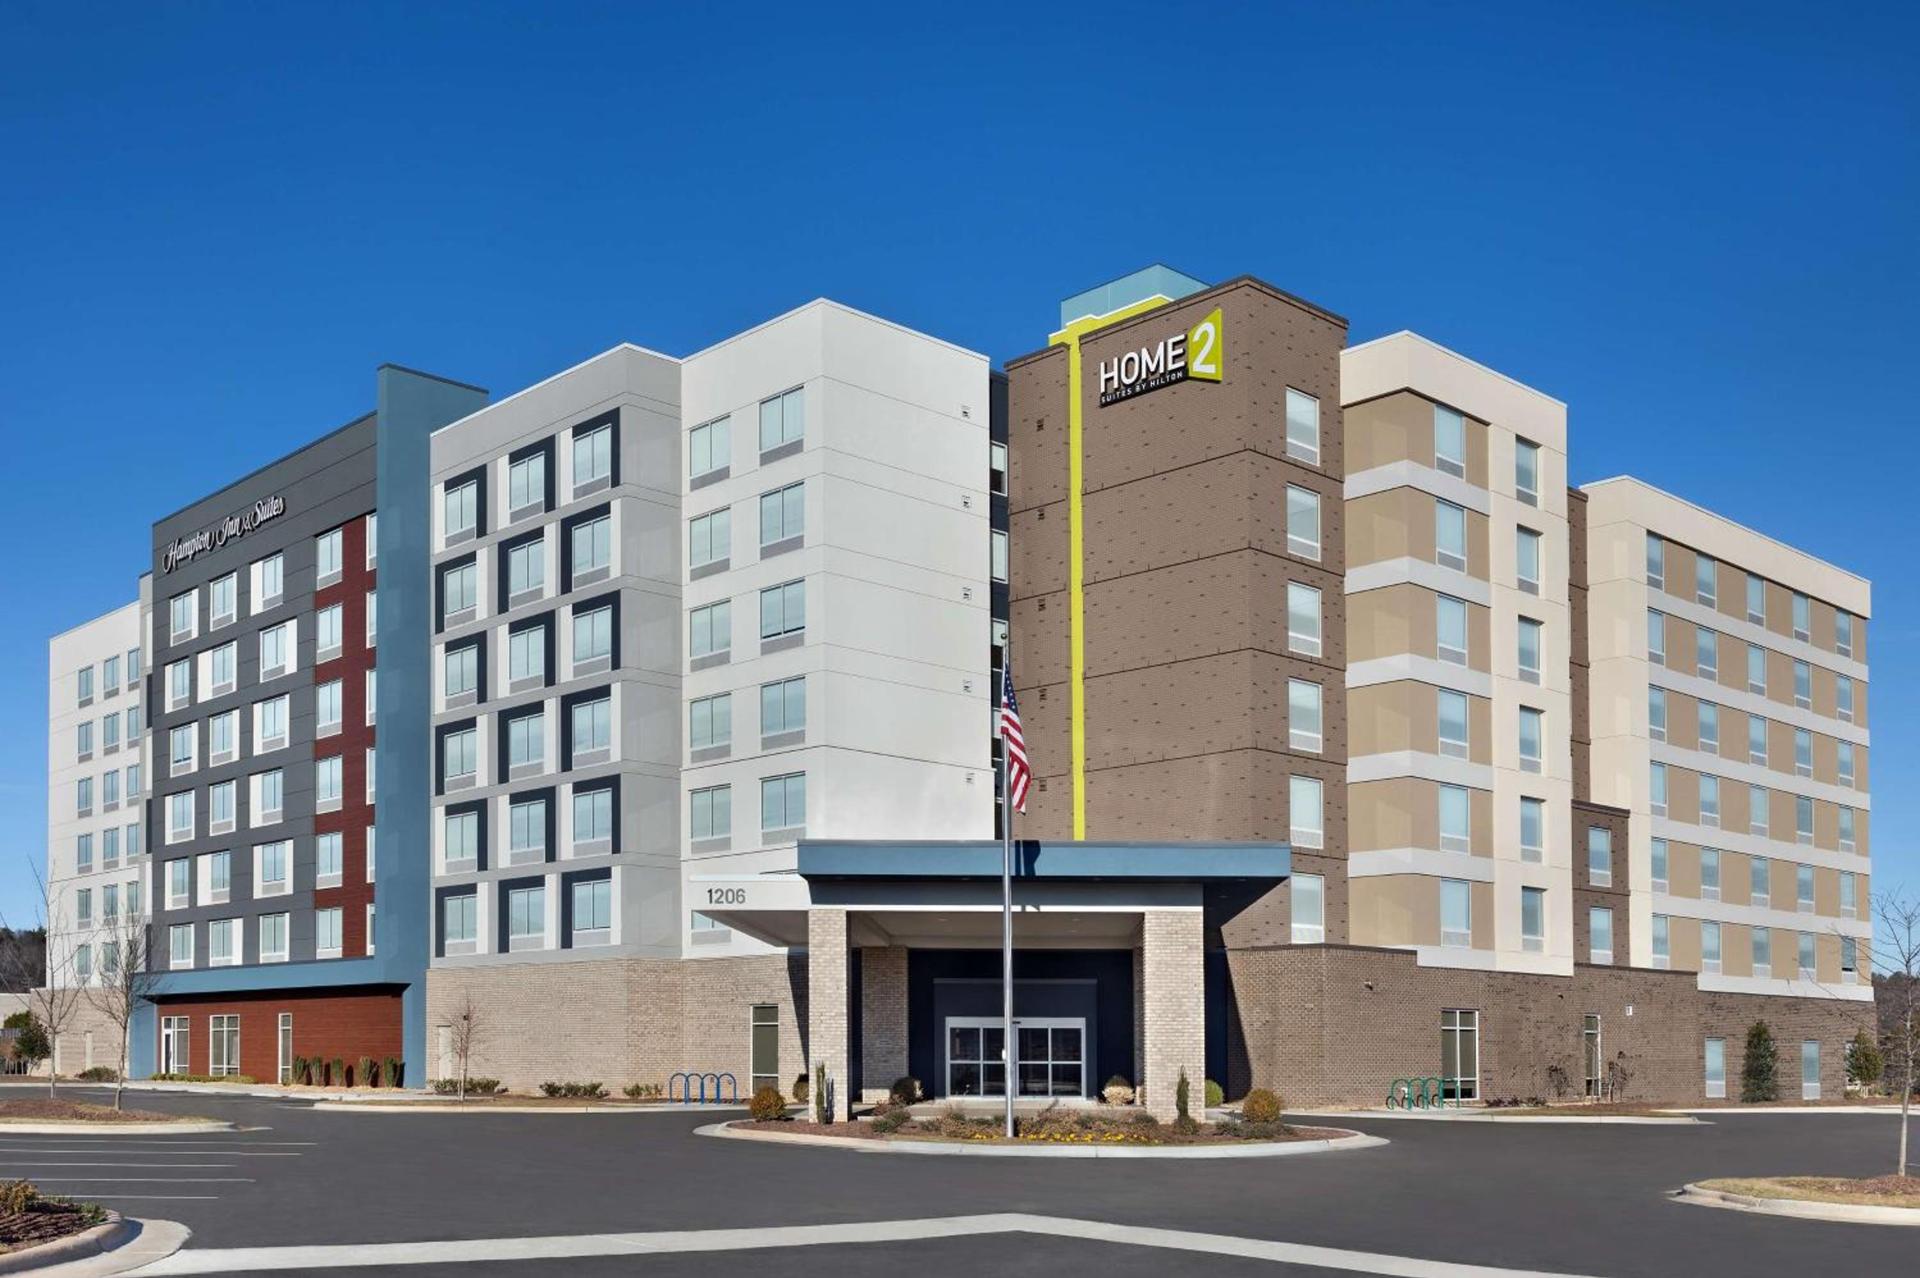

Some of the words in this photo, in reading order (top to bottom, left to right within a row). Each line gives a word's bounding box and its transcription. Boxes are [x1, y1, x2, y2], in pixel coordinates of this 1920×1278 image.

[1100, 333, 1185, 393] HOME
[1192, 322, 1216, 374] 2
[1101, 387, 1132, 404] SUITES
[1135, 383, 1147, 393] BY
[1150, 371, 1183, 388] HILTON
[162, 530, 214, 573] Hampton
[216, 516, 243, 545] Inn
[250, 495, 284, 526] Suites
[707, 888, 746, 904] 1206
